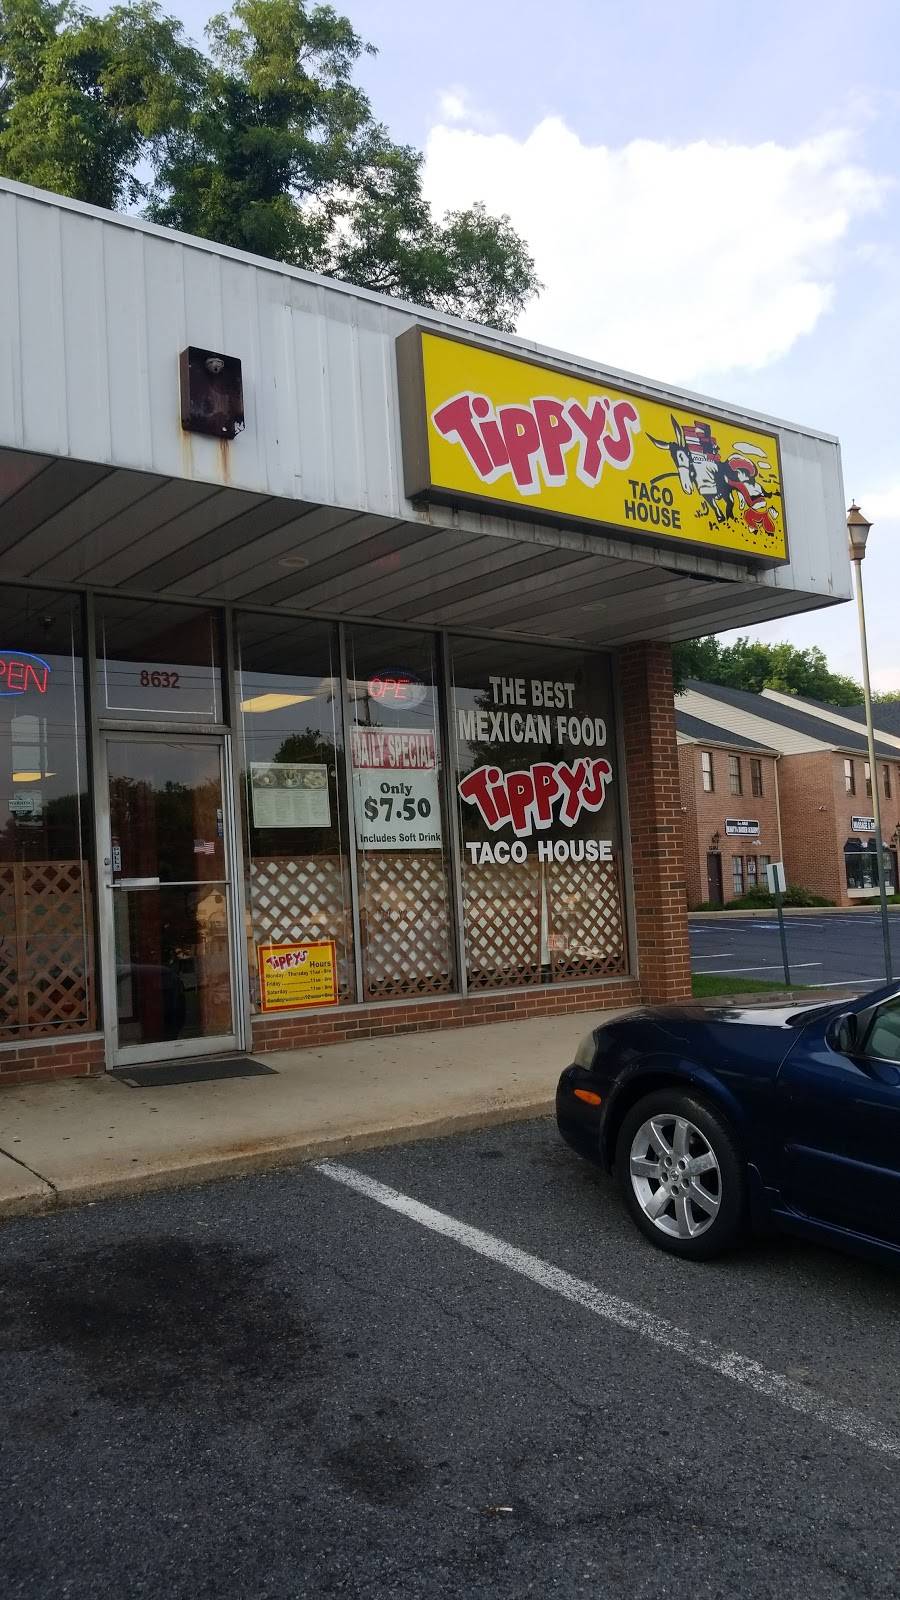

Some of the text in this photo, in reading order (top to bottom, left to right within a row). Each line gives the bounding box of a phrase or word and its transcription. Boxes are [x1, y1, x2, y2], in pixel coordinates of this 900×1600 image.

[628, 479, 674, 507] TACO
[624, 499, 682, 530] HOUSE
[140, 669, 180, 688] 8632
[489, 676, 576, 709] THE BEST
[457, 710, 608, 747] MEXICAN FOOD
[353, 734, 435, 768] DAILY SPECIAL
[380, 782, 413, 797] Only
[364, 795, 432, 823] $7.50
[360, 832, 441, 844] Includes Soft Drink
[466, 840, 613, 865] TACO HOUSE
[309, 960, 332, 969] Hours
